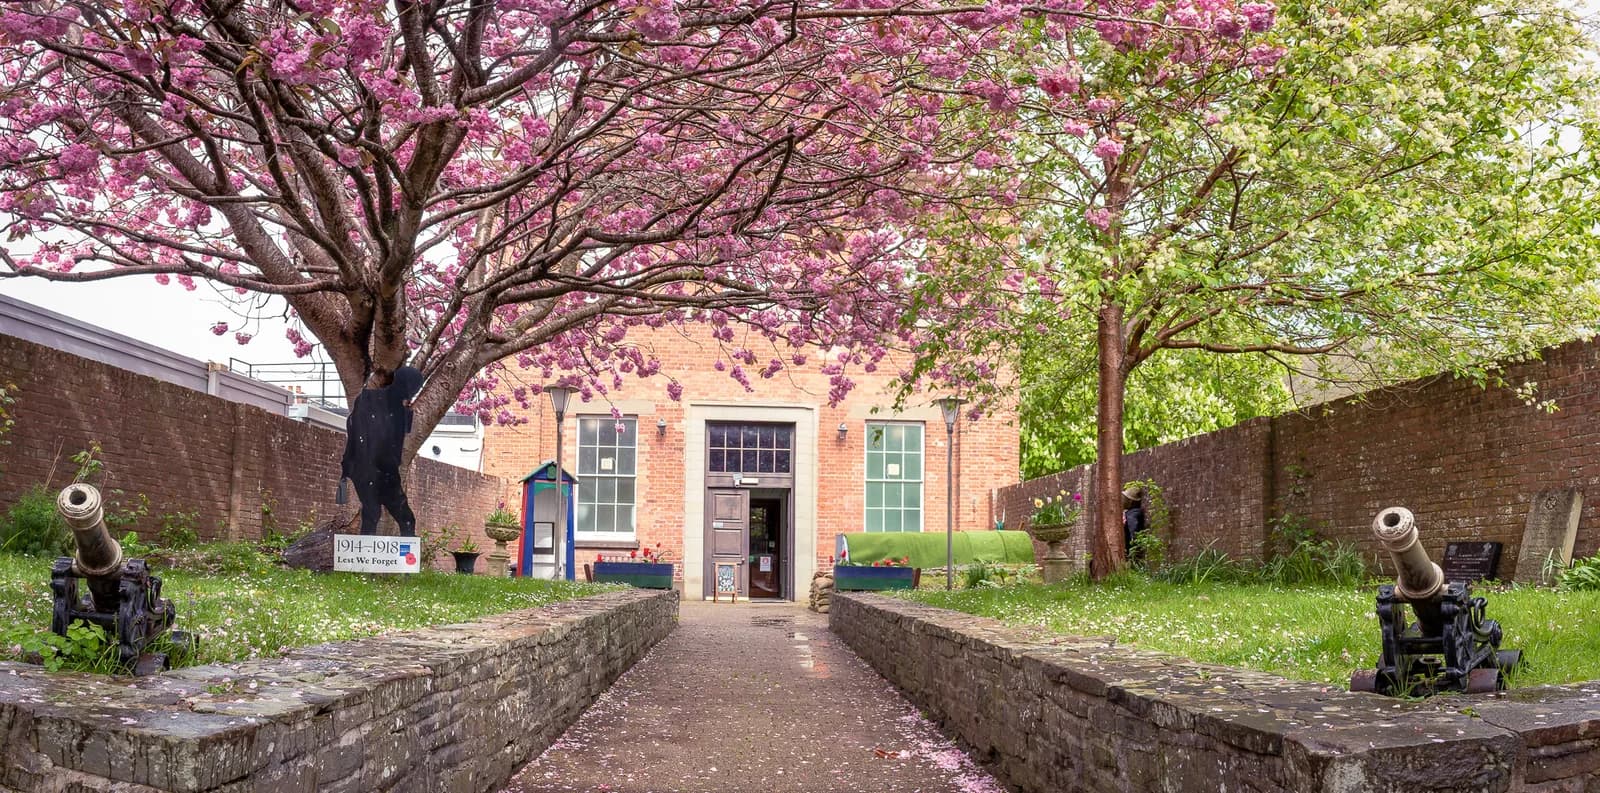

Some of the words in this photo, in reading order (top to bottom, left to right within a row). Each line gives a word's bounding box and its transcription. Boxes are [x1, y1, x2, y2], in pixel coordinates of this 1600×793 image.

[337, 556, 354, 564] Lest
[356, 556, 370, 565] We
[371, 557, 398, 567] Forget
